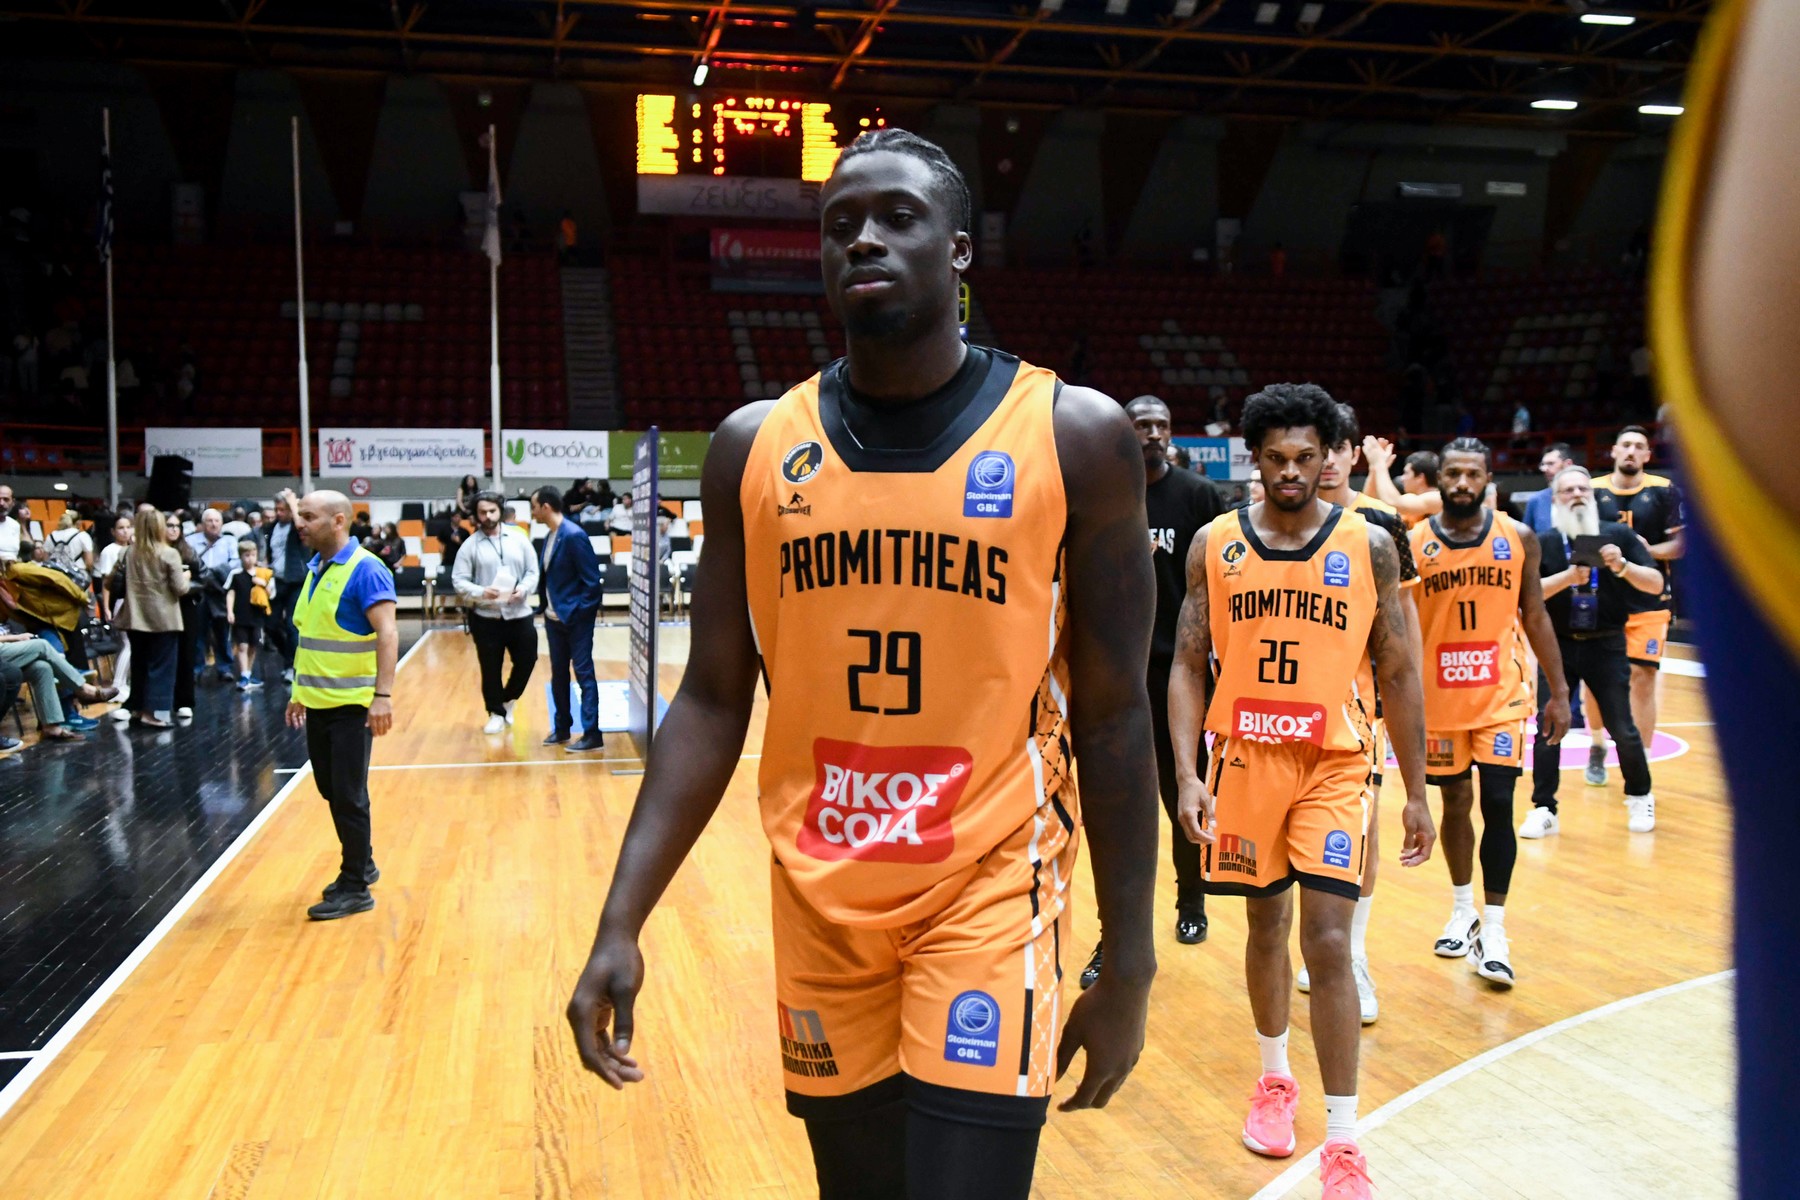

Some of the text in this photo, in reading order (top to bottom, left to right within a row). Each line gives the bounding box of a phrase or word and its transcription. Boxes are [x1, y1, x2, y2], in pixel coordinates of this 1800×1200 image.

[966, 491, 1012, 501] Stoiximan
[976, 503, 1000, 513] GBL
[780, 529, 1009, 606] PROMITHEAS
[1423, 565, 1512, 598] PROMITHEAS
[1228, 588, 1348, 632] ROMITHEAS
[1457, 600, 1477, 631] 11
[847, 628, 922, 716] 29
[1258, 638, 1300, 685] 26
[1443, 665, 1492, 682] COLA
[947, 1034, 997, 1049] Stoiximan
[957, 1047, 982, 1060] GBL
